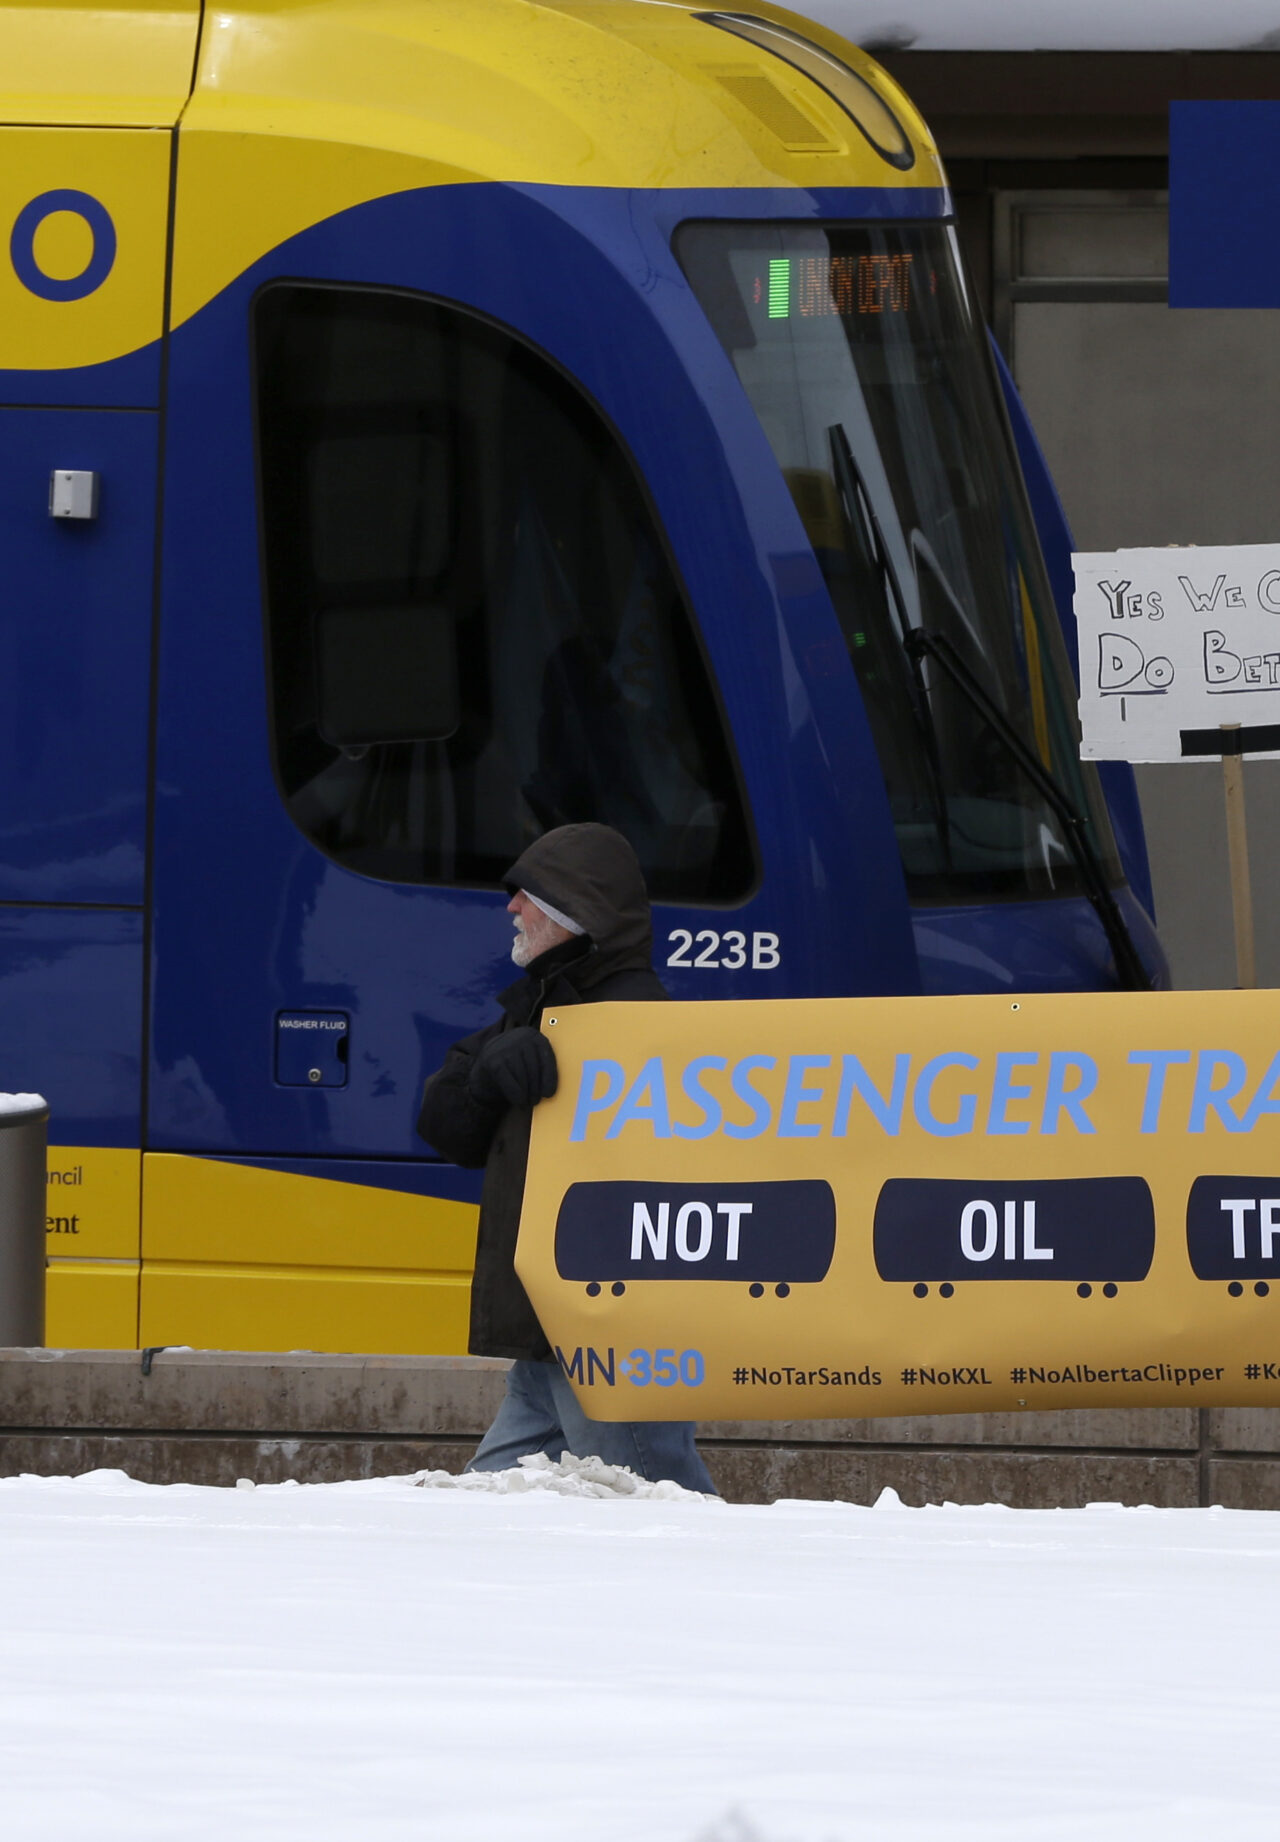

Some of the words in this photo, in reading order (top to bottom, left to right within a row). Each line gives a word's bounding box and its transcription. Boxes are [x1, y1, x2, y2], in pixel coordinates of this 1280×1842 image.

[10, 188, 117, 302] O
[1097, 579, 1164, 620] YES
[1178, 574, 1246, 612] WE
[1098, 632, 1174, 689] DO
[667, 929, 781, 970] 223B
[279, 1020, 318, 1029] WASHER
[320, 1021, 346, 1030] FLUID
[568, 1051, 1098, 1142] PASSENGER
[46, 1166, 82, 1186] ncil
[630, 1201, 753, 1262] NOT
[960, 1199, 1054, 1262] OIL
[555, 1345, 616, 1386] MN
[628, 1348, 706, 1388] 350
[732, 1366, 882, 1386] #NoTarSands
[900, 1367, 992, 1386] #NoKXL
[1010, 1363, 1225, 1387] #NoAlbertaClipper
